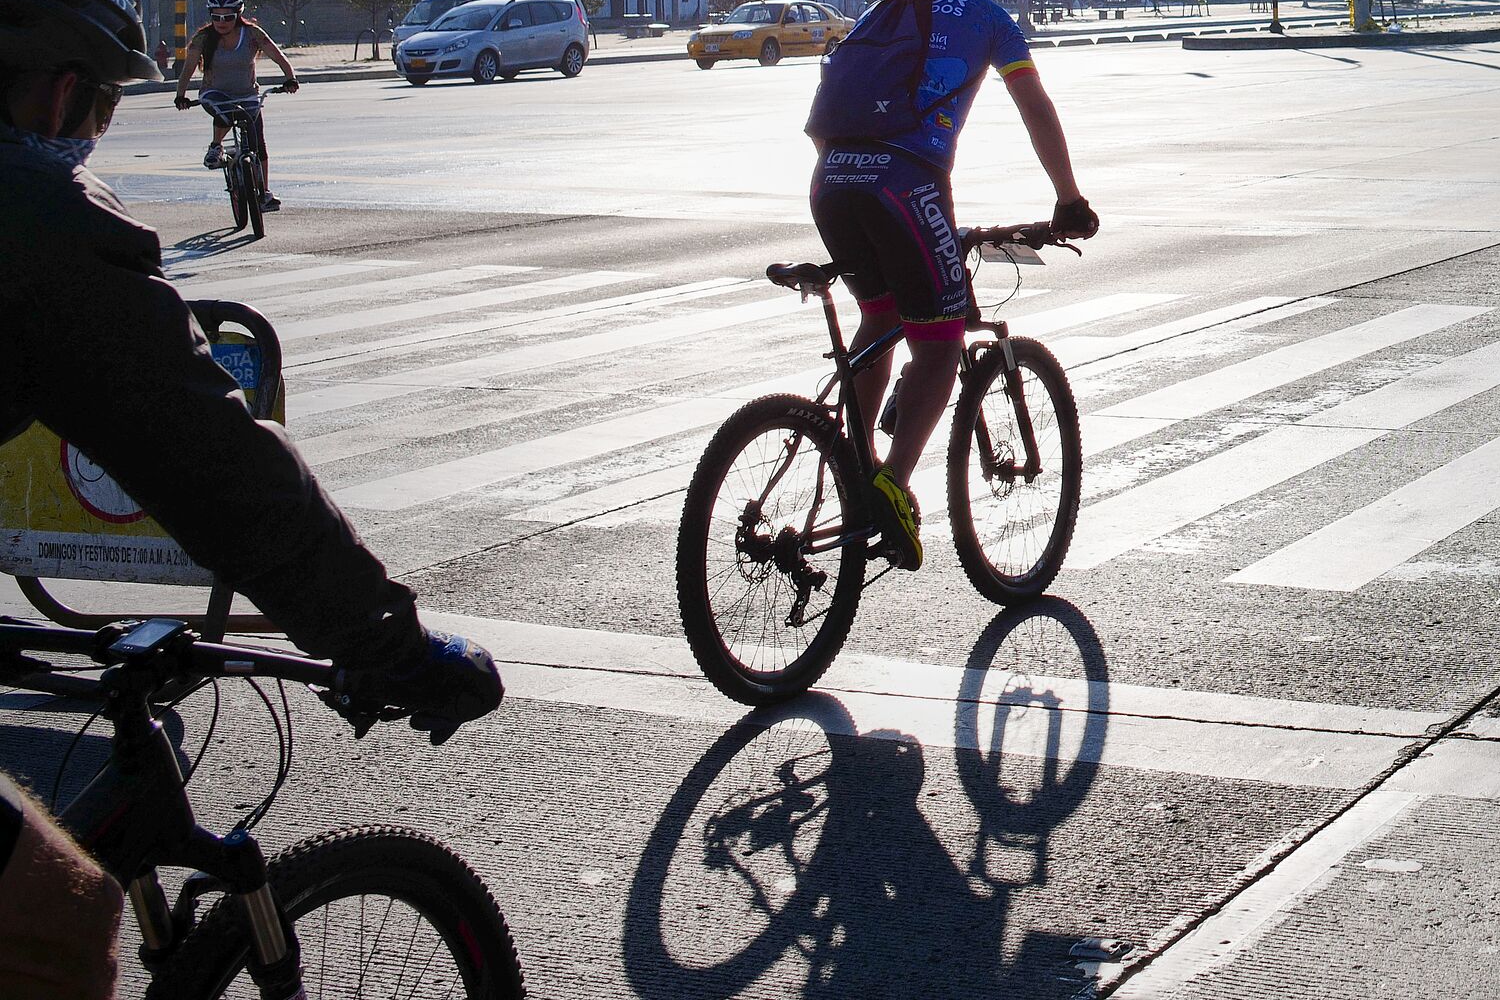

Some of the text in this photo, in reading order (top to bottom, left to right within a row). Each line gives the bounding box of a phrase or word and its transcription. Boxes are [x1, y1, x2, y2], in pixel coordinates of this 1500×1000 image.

[827, 149, 892, 168] lampre
[920, 191, 962, 282] lampre
[38, 542, 77, 560] DOMINGOS
[79, 544, 84, 560] Y
[85, 545, 120, 562] FESTIVOS
[121, 547, 132, 563] DE
[133, 547, 148, 564] 7:00
[167, 549, 172, 565] A
